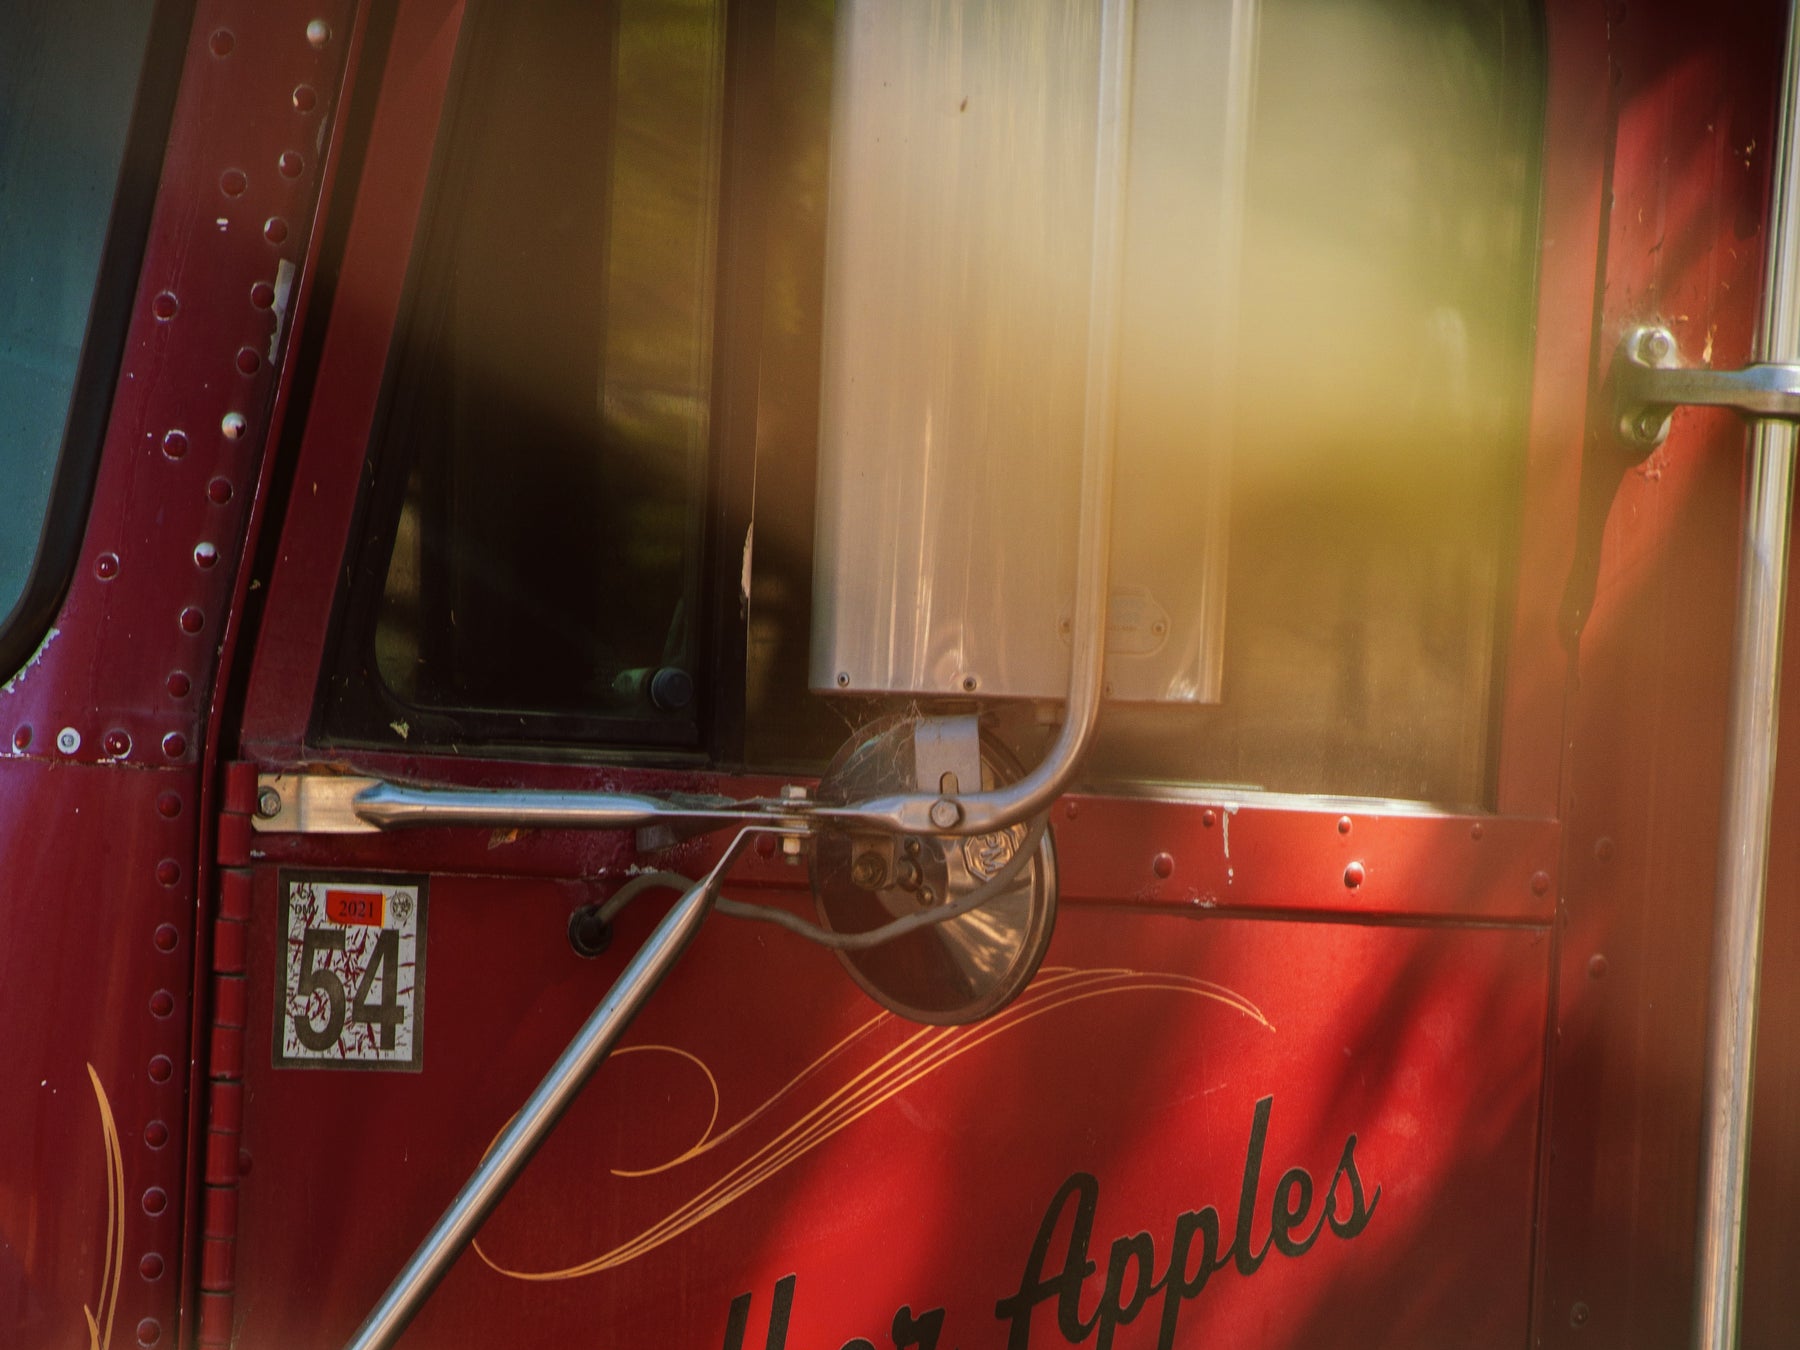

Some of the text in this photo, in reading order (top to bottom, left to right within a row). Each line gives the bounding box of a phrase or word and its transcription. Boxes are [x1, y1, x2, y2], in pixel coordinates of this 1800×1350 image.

[294, 904, 319, 915] DMV
[339, 900, 375, 918] 2021
[294, 928, 405, 1051] 54
